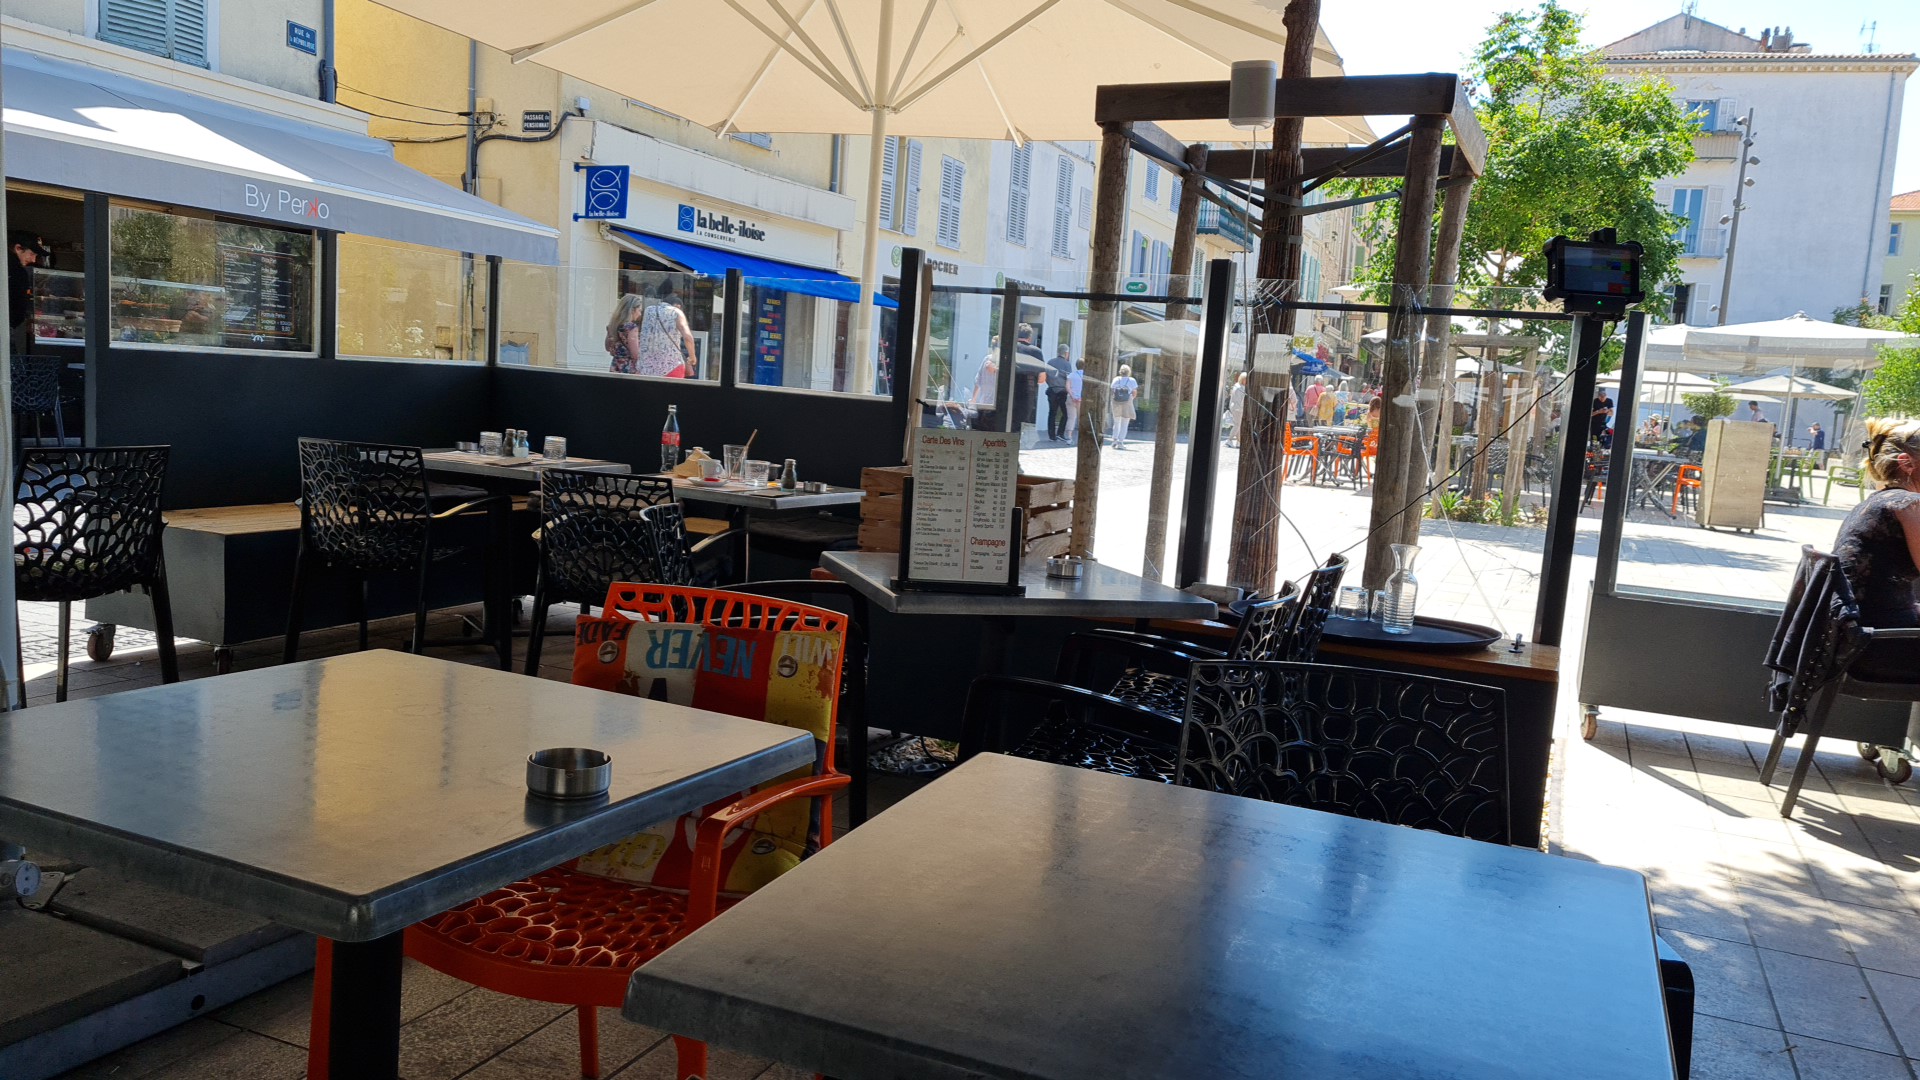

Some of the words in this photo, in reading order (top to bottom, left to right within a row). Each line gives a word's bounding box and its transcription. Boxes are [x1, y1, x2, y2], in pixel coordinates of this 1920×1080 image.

[245, 183, 271, 213] By
[278, 189, 330, 220] Perko
[696, 208, 707, 229] la
[708, 211, 766, 242] belle-iloise
[696, 229, 703, 237] LA
[703, 231, 737, 244] CONSERVERIE
[922, 435, 939, 445] Carte
[940, 436, 951, 445] Des
[952, 437, 965, 446] Vins
[970, 536, 1006, 548] Champagne
[645, 628, 758, 681] NEVER
